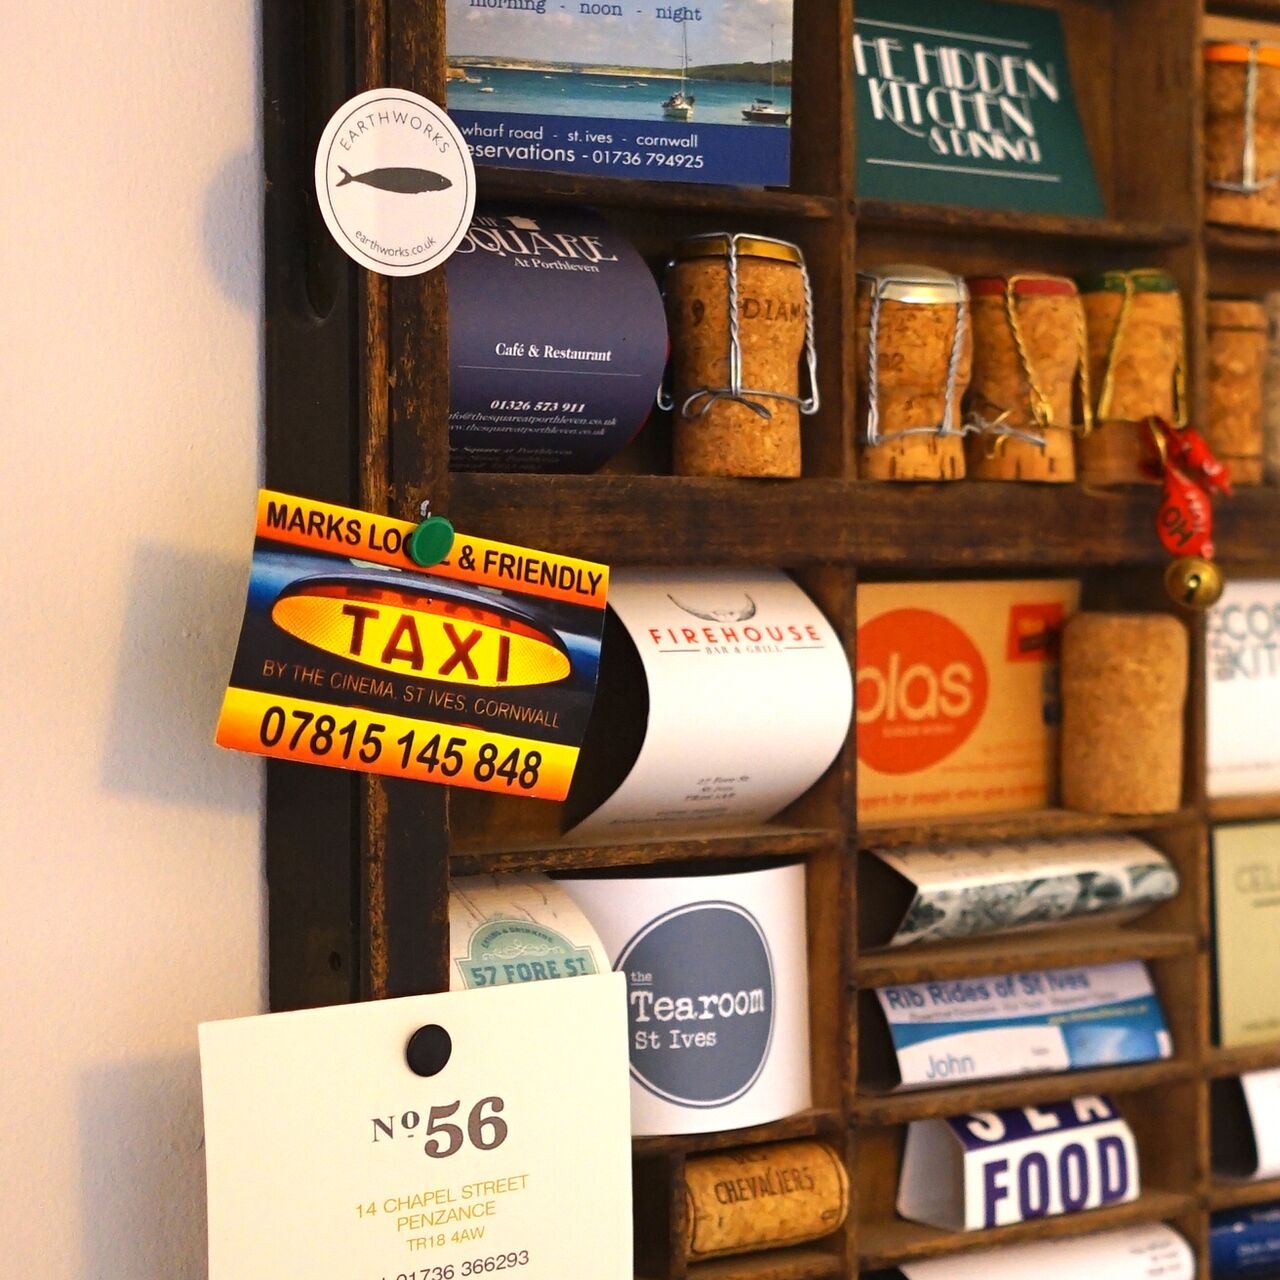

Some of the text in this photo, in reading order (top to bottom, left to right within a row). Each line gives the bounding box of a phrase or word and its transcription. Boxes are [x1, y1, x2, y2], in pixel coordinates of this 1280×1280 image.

[579, 2, 622, 16] noon
[656, 6, 702, 23] night
[853, 34, 1060, 104] HE HIDDEN
[868, 77, 1036, 138] KITCHEN
[338, 109, 451, 155] EARTHWORKS
[461, 125, 504, 138] wharf
[508, 126, 543, 140] road
[636, 135, 698, 148] cornwall
[467, 143, 704, 169] eservations 01736 794925
[354, 227, 438, 259] earthworks.co.uk
[514, 257, 600, 273] At Porthleven
[495, 341, 612, 364] Café & Restaurant
[449, 412, 617, 426] nfo@thesquareatporthleven.co.uk
[490, 400, 586, 413] 01326 573 911
[266, 501, 362, 545] MARKS
[458, 544, 476, 573] &
[483, 550, 603, 596] FRIENDLY
[341, 603, 511, 683] TAXI
[647, 623, 824, 646] FIREHOUSE
[262, 659, 287, 678] BY
[292, 665, 325, 687] THE
[402, 684, 425, 704] ST
[473, 698, 561, 730] CORNWALL
[259, 705, 542, 789] 07815 145 848
[470, 966, 497, 986] 57
[503, 960, 561, 984] FORE
[630, 970, 654, 983] the
[630, 987, 765, 1023] Tearoom
[885, 988, 925, 1010] Rib
[928, 981, 991, 1005] Rides
[995, 978, 1014, 999] of
[1018, 975, 1044, 995] St
[635, 1029, 718, 1051] St Ives
[926, 1054, 975, 1080] John
[355, 1174, 530, 1219] 14 CHAPEL STREET
[714, 1166, 816, 1206] CHEVALIERS
[983, 1135, 1128, 1230] FOOD
[396, 1200, 497, 1233] PENZANCE
[407, 1225, 485, 1252] TR18 4AW
[460, 1249, 530, 1278] 366293
